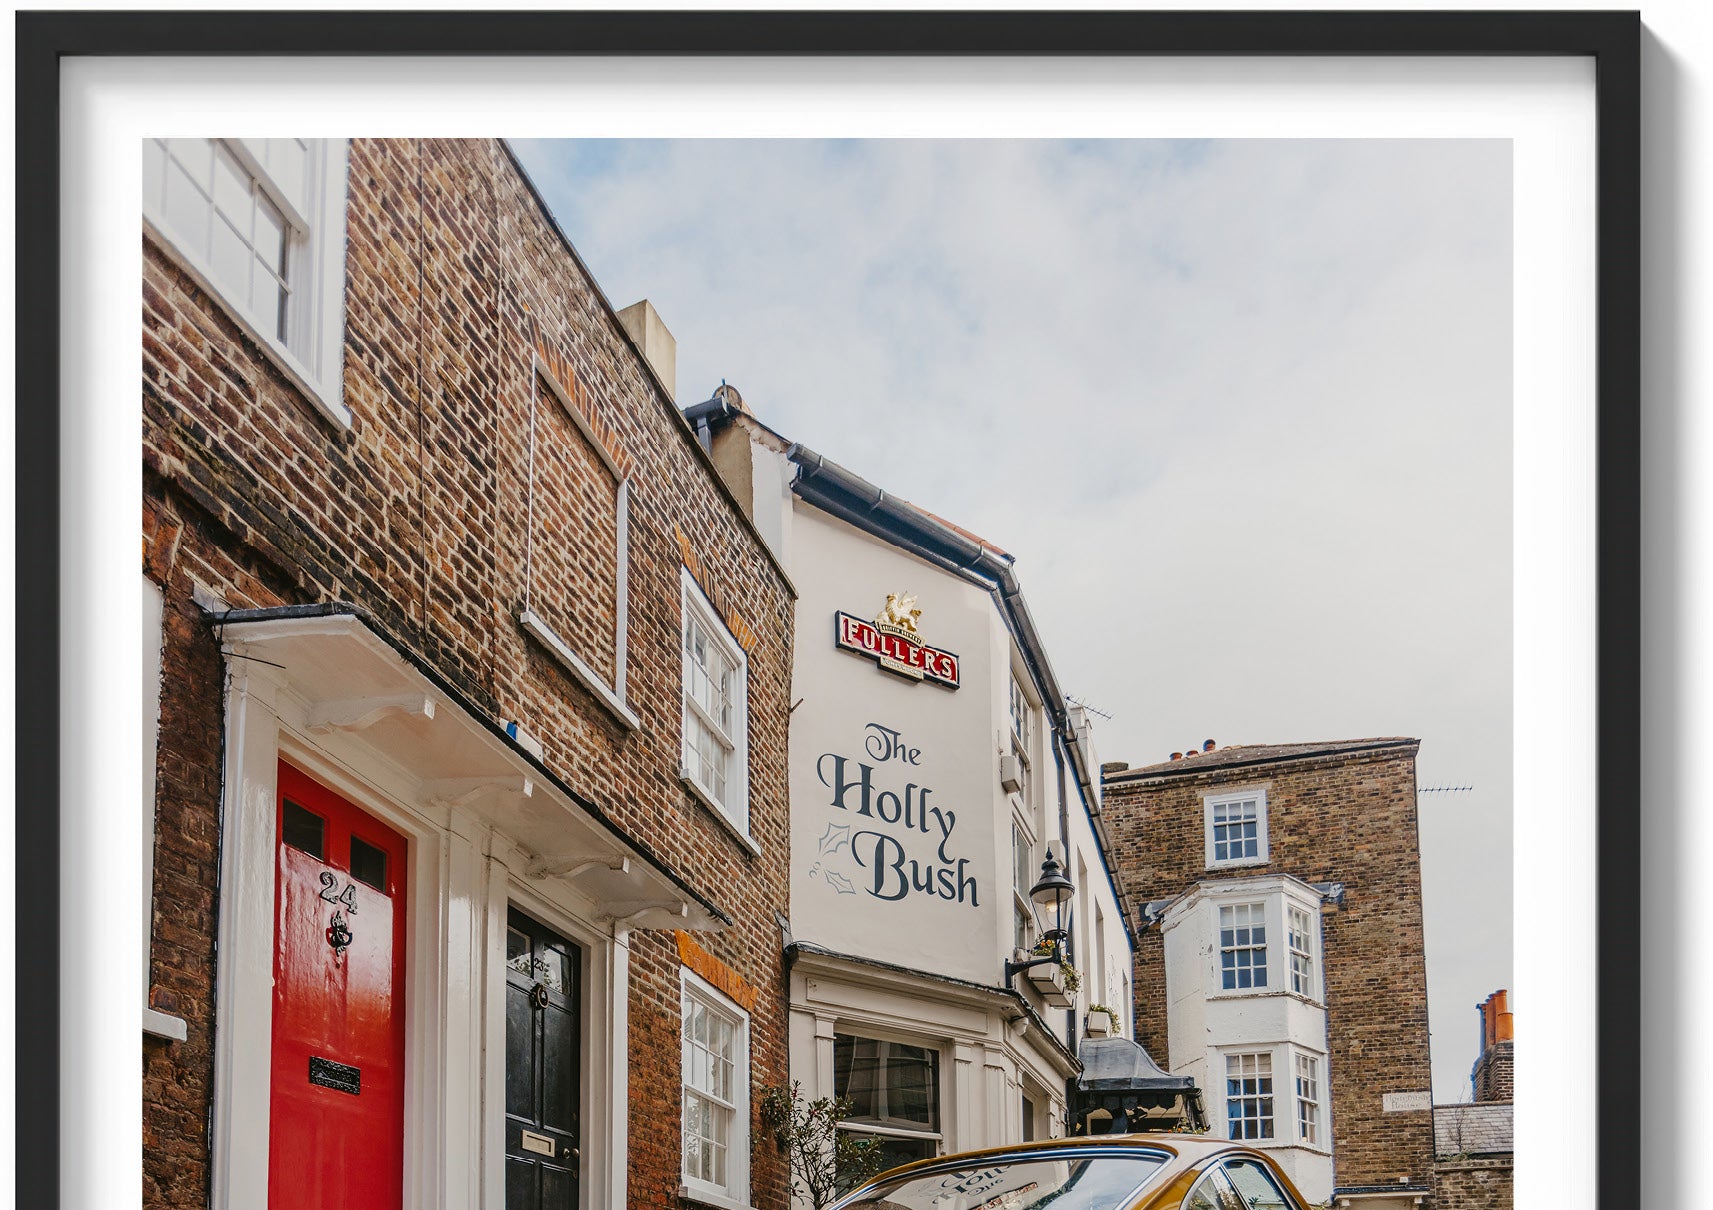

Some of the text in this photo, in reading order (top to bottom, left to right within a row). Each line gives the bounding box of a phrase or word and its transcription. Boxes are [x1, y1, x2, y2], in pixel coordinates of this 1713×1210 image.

[864, 722, 921, 765] The
[816, 753, 956, 864] Holly
[851, 830, 979, 907] Bush
[319, 871, 357, 915] 24
[534, 957, 543, 972] 23
